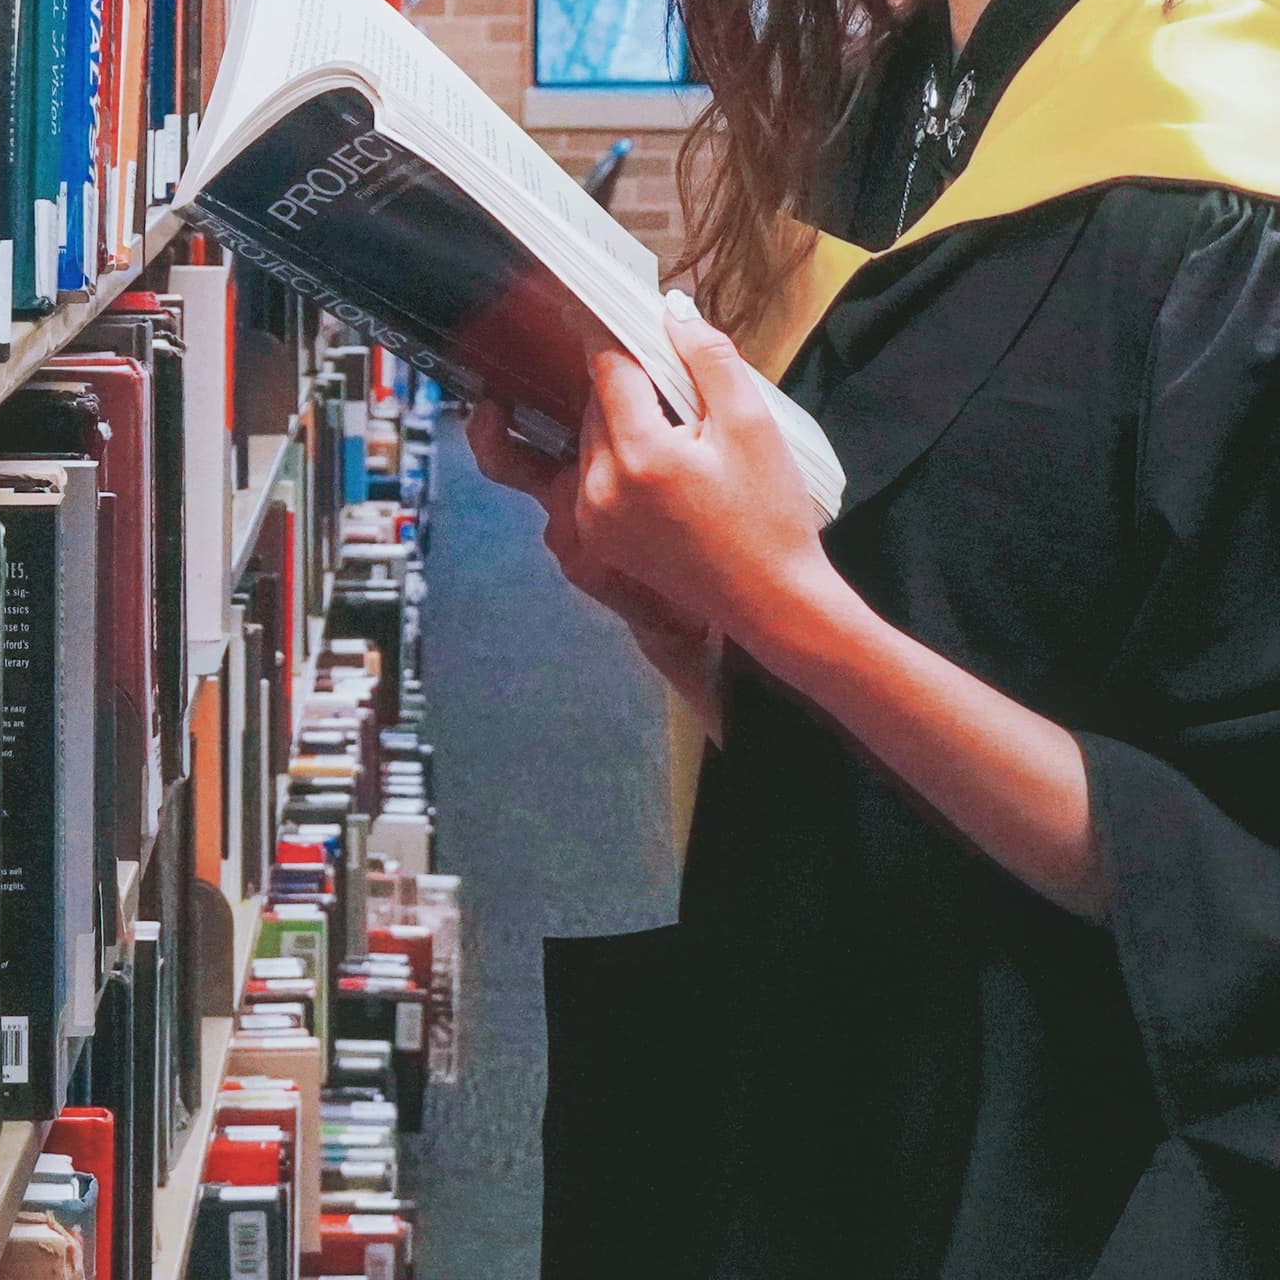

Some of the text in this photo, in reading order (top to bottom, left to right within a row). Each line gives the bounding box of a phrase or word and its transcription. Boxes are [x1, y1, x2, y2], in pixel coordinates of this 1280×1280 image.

[51, 65, 60, 136] Vision
[197, 219, 441, 369] PROJECTIONS 5
[21, 623, 30, 632] to
